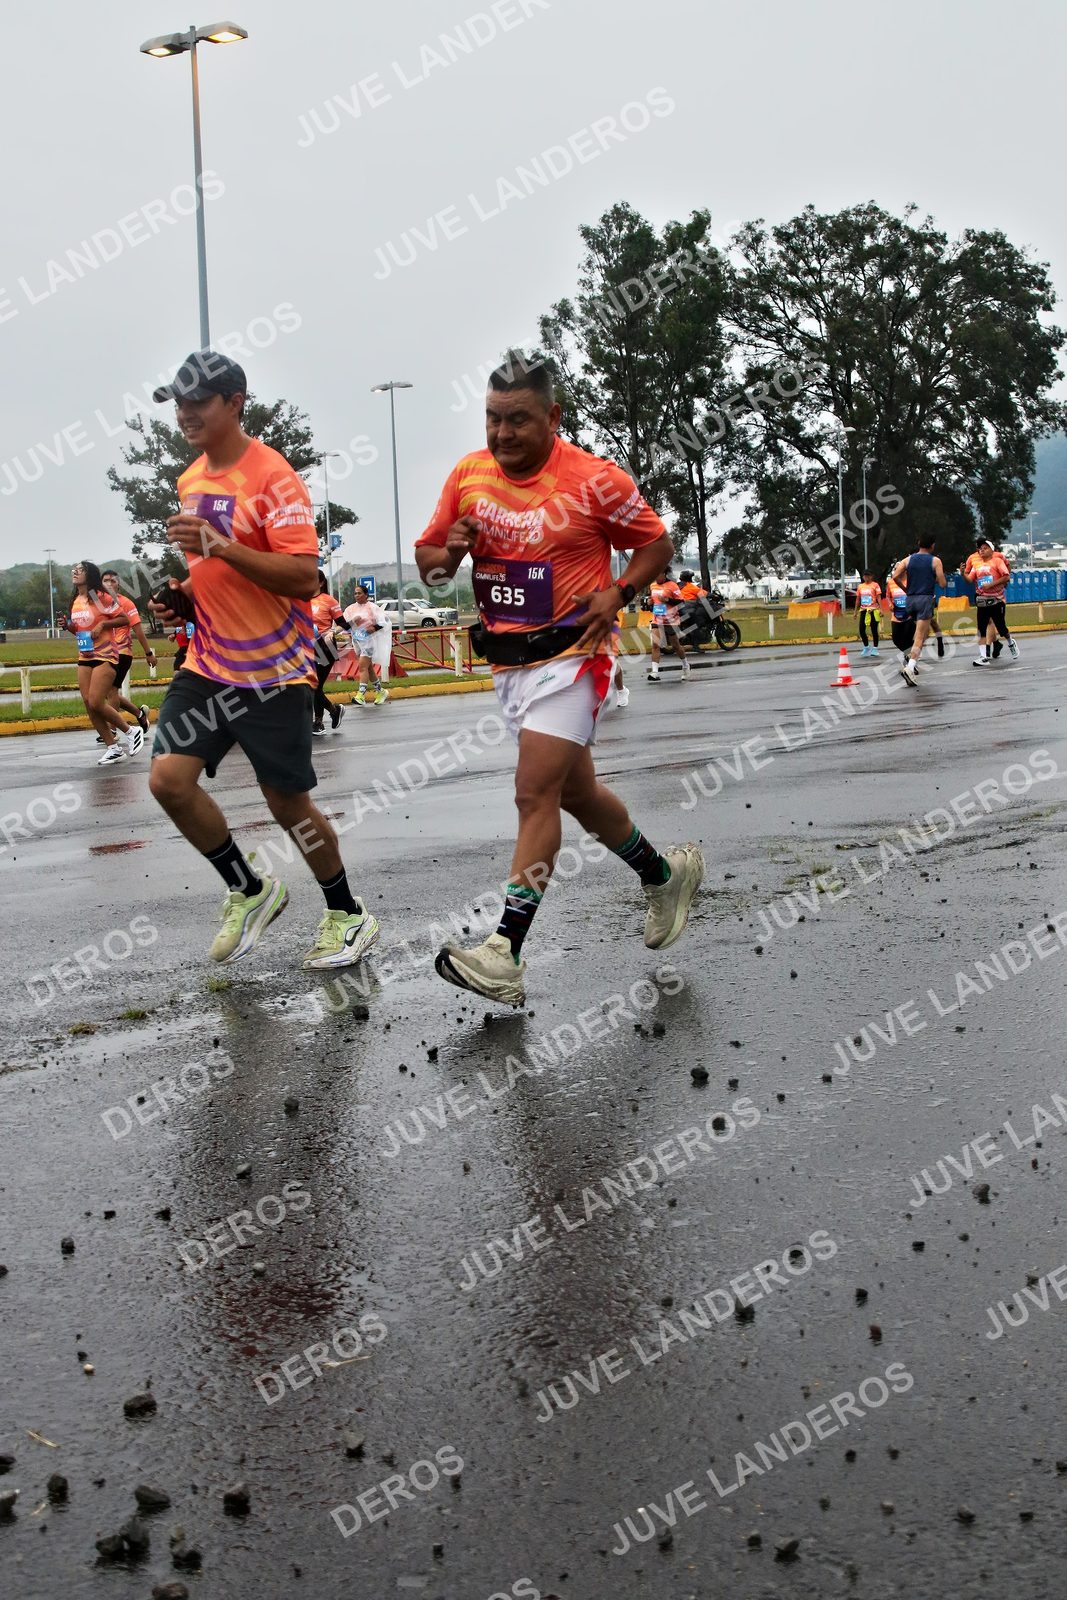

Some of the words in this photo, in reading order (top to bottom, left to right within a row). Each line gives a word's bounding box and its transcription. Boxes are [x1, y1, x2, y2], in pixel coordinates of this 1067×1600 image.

[213, 499, 229, 512] 15K
[476, 497, 546, 529] CARRERA
[527, 566, 546, 580] 15K
[490, 585, 525, 607] 635
